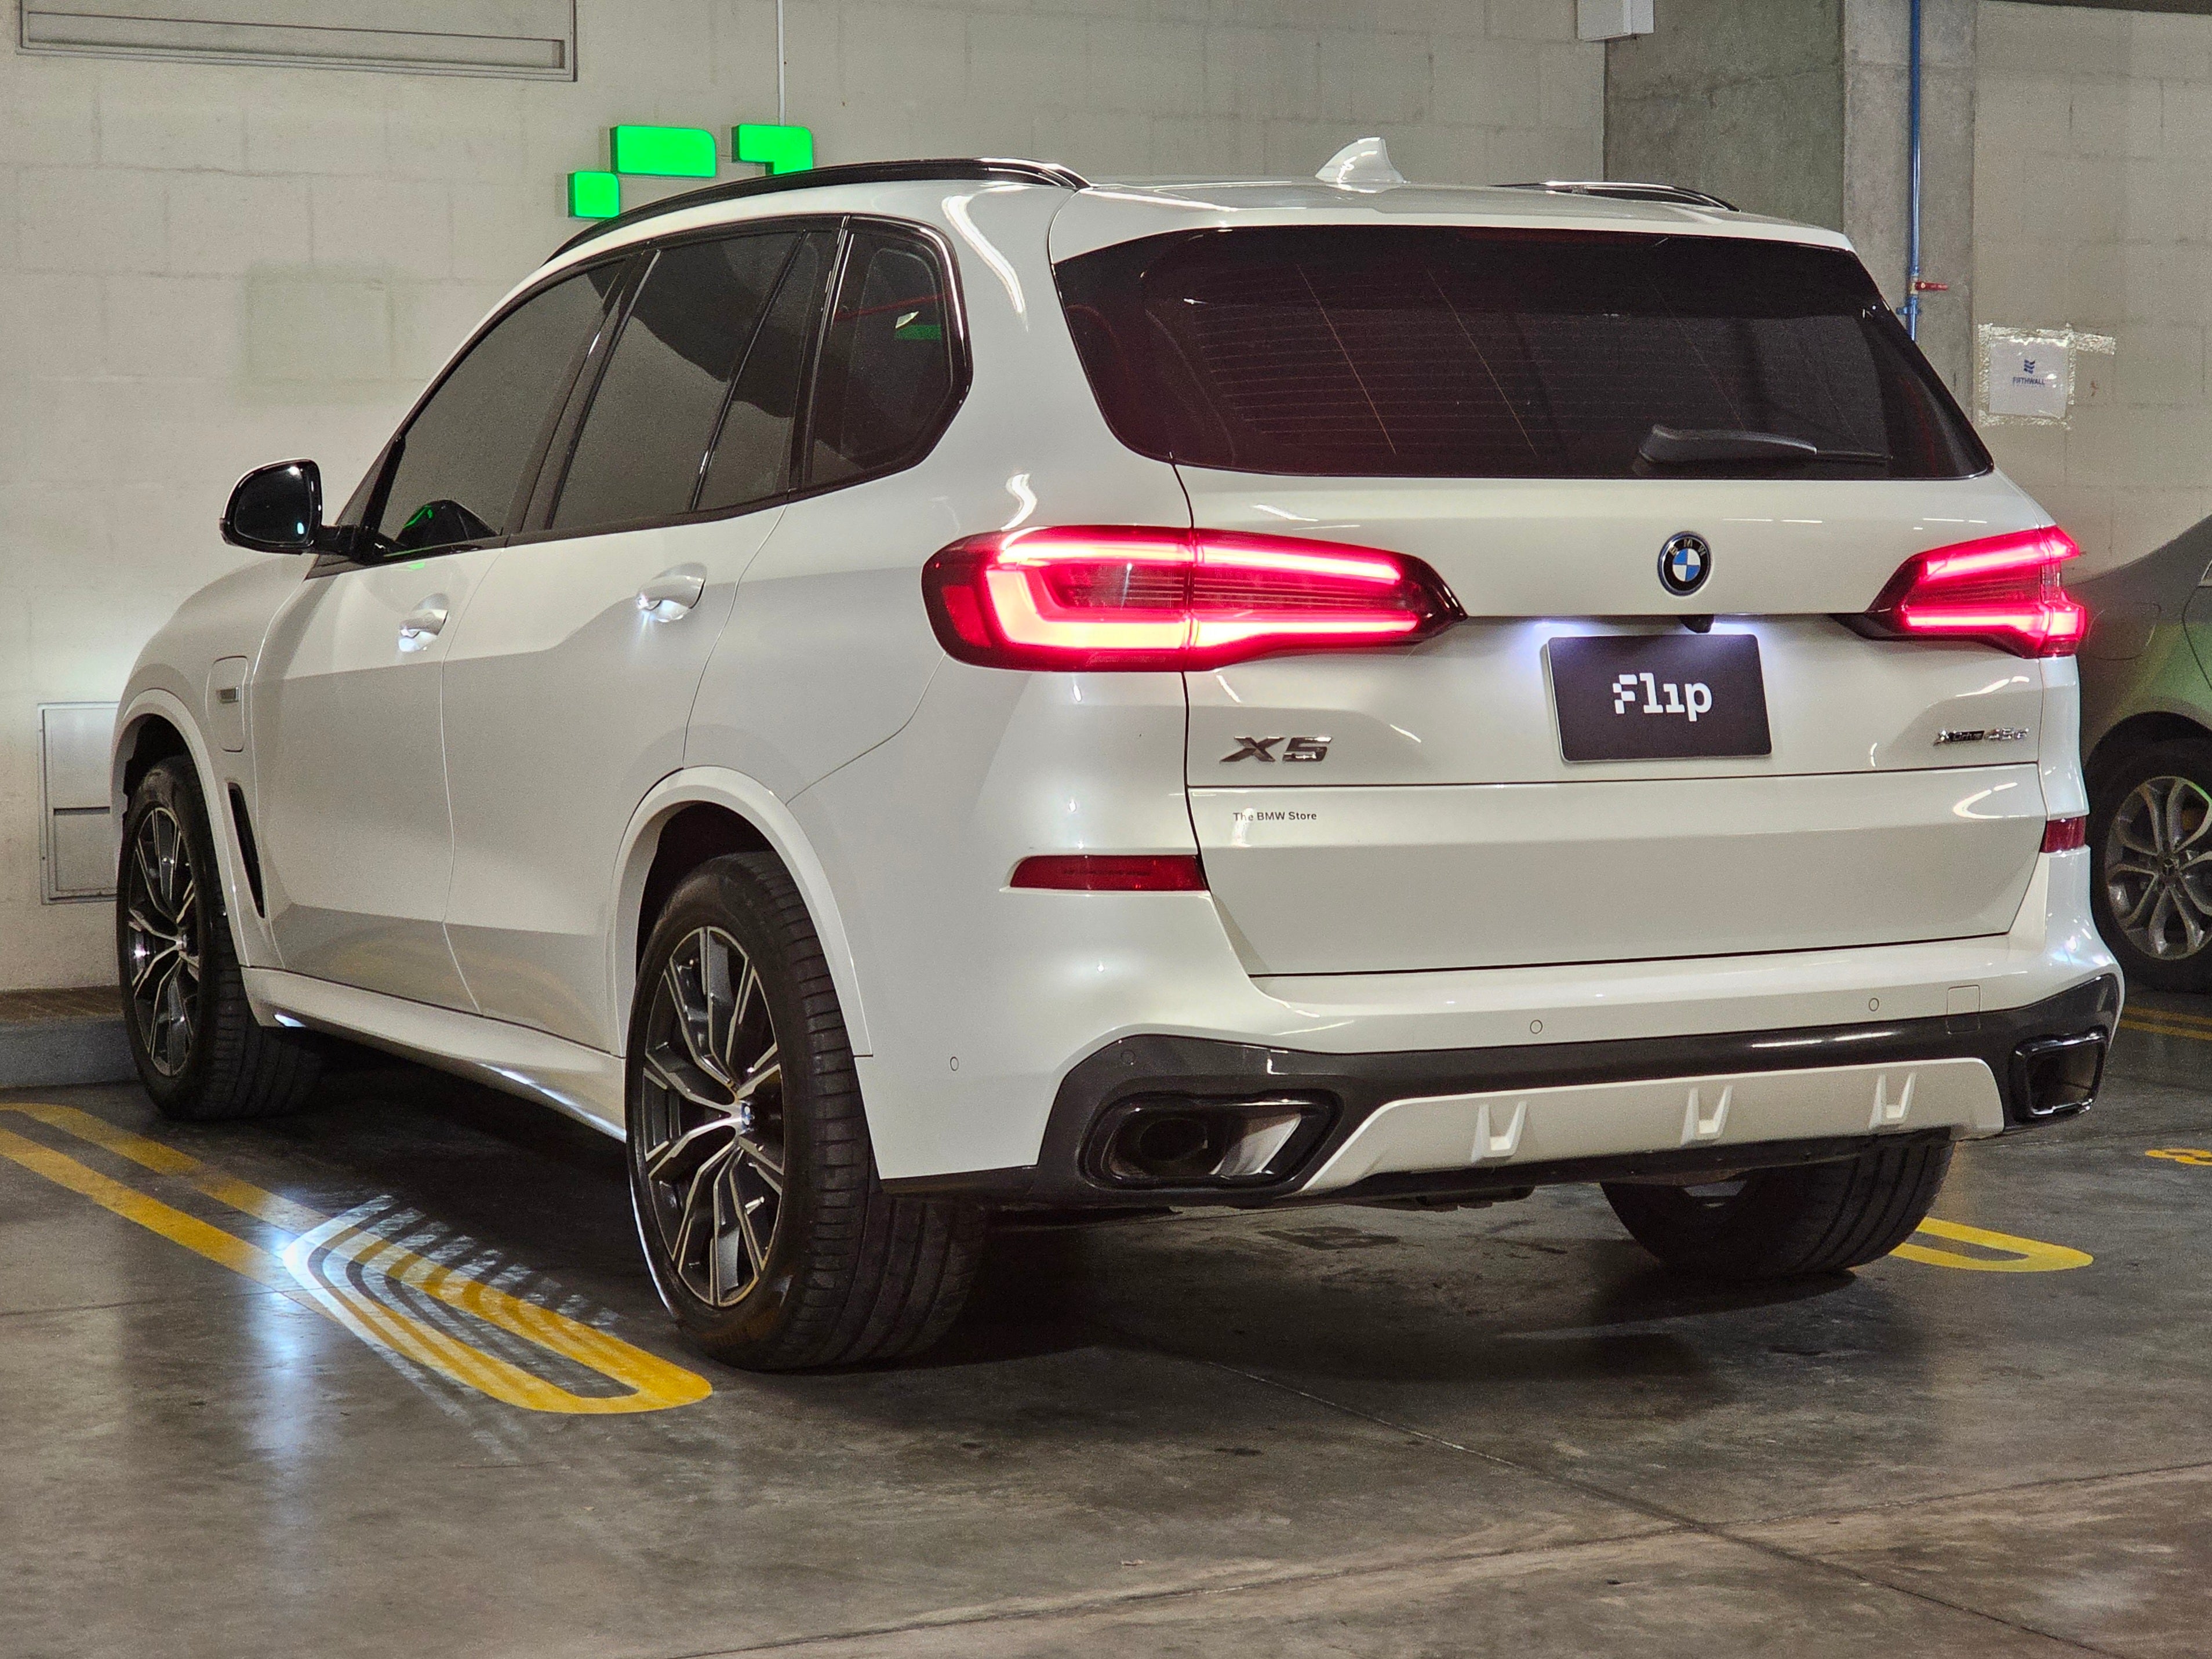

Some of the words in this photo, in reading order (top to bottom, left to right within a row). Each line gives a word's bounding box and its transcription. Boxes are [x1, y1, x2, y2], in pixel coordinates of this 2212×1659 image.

[1669, 538, 1707, 556] BMW
[1613, 672, 1712, 722] Flip
[1220, 737, 1333, 762] X5
[1233, 812, 1254, 821] The
[1257, 812, 1285, 821] BMW
[1289, 812, 1317, 820] Store
